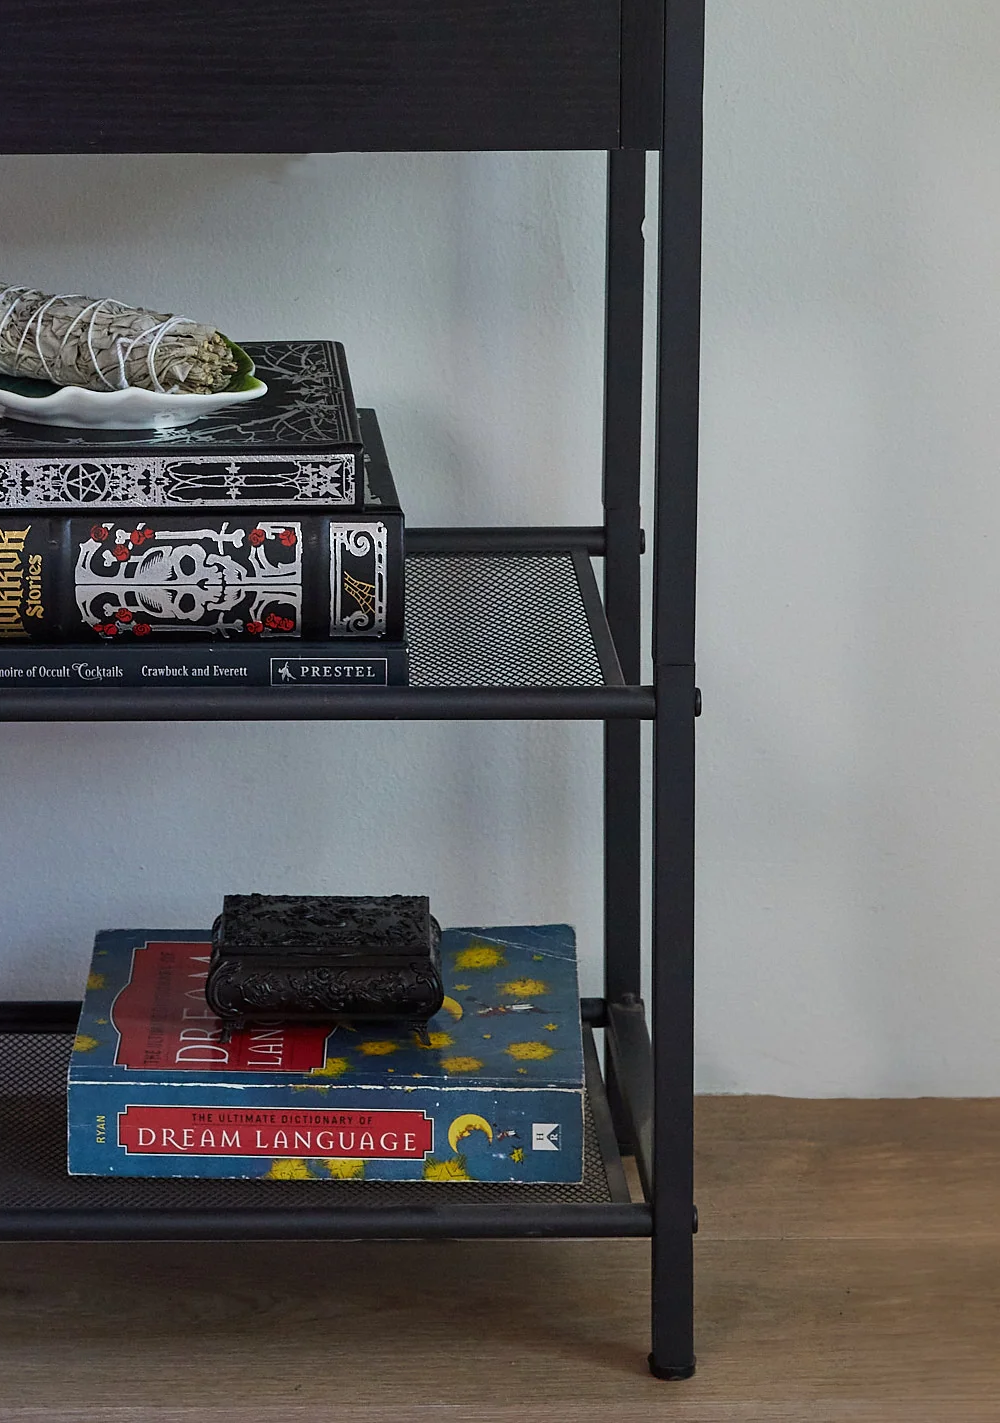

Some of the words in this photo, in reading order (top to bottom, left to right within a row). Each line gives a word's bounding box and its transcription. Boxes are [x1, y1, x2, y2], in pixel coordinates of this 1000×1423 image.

[25, 554, 45, 619] Stories
[26, 664, 38, 678] of
[38, 665, 71, 678] Occult
[71, 662, 124, 681] Cocktails
[141, 665, 189, 677] Crawbuck
[191, 665, 210, 677] and
[213, 665, 248, 677] Everett
[300, 665, 376, 678] PRESTEL
[192, 1113, 212, 1123] THE
[219, 1113, 276, 1124] ULTIMATE
[281, 1114, 353, 1125] DICTIONARY
[358, 1115, 373, 1125] OF
[95, 1115, 106, 1144] RYAN
[137, 1127, 242, 1151] DREAM
[256, 1129, 417, 1151] LANGUAGE
